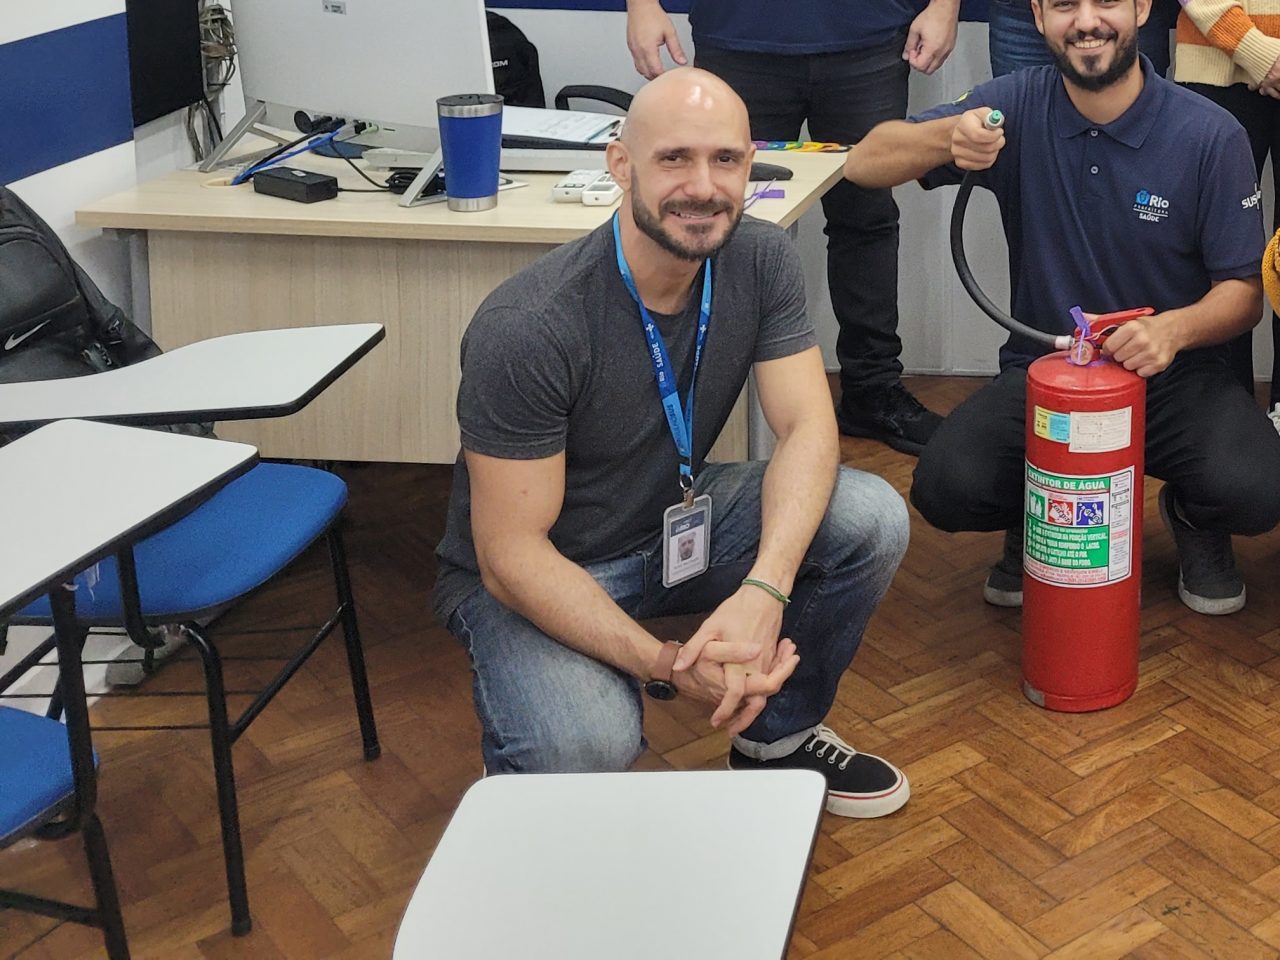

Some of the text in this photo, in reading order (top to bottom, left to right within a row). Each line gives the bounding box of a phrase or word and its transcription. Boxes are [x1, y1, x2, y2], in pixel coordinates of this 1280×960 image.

[1149, 194, 1170, 208] Rio
[651, 342, 664, 368] SAÚDE
[1063, 481, 1077, 490] DE
[1078, 480, 1106, 490] ÁGUA
